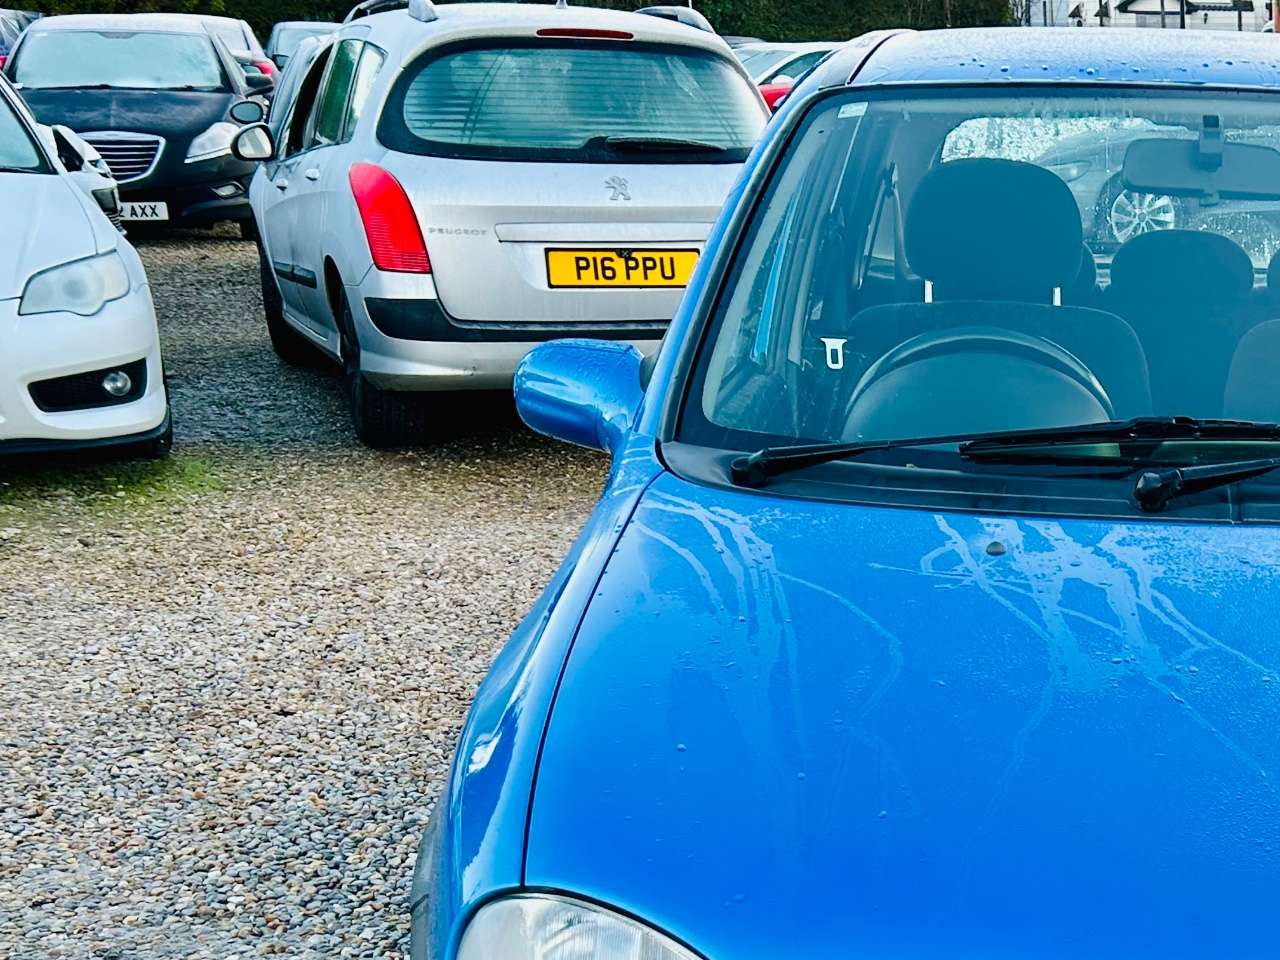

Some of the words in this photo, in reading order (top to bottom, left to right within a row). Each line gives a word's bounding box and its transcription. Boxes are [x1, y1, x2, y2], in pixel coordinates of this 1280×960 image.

[130, 205, 159, 217] AXX
[428, 227, 487, 236] PEUGEOT
[574, 256, 617, 281] P16
[624, 256, 676, 281] PPU
